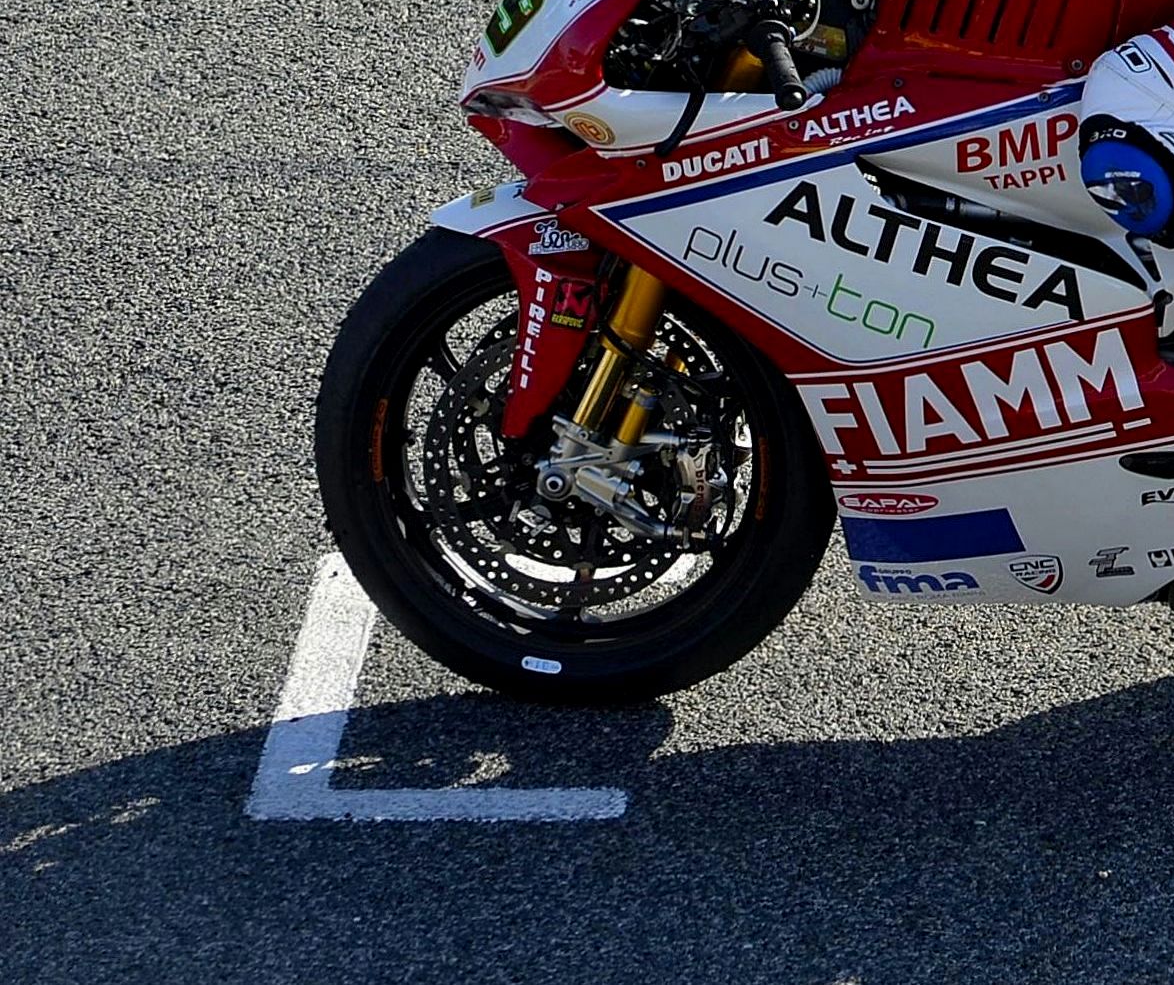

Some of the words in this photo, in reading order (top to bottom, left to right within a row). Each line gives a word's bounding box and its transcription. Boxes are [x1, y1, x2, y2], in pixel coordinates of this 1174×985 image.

[803, 95, 916, 142] ALTHEA
[662, 137, 769, 183] DUCATI
[957, 113, 1079, 174] BMP
[983, 163, 1067, 191] TAPPI
[763, 180, 1086, 322] ALTHEA
[519, 267, 552, 389] PIRELLI
[796, 327, 1146, 456] FIAMM
[842, 496, 936, 509] SAPAL
[857, 564, 981, 595] fma
[1009, 558, 1056, 571] CNC
